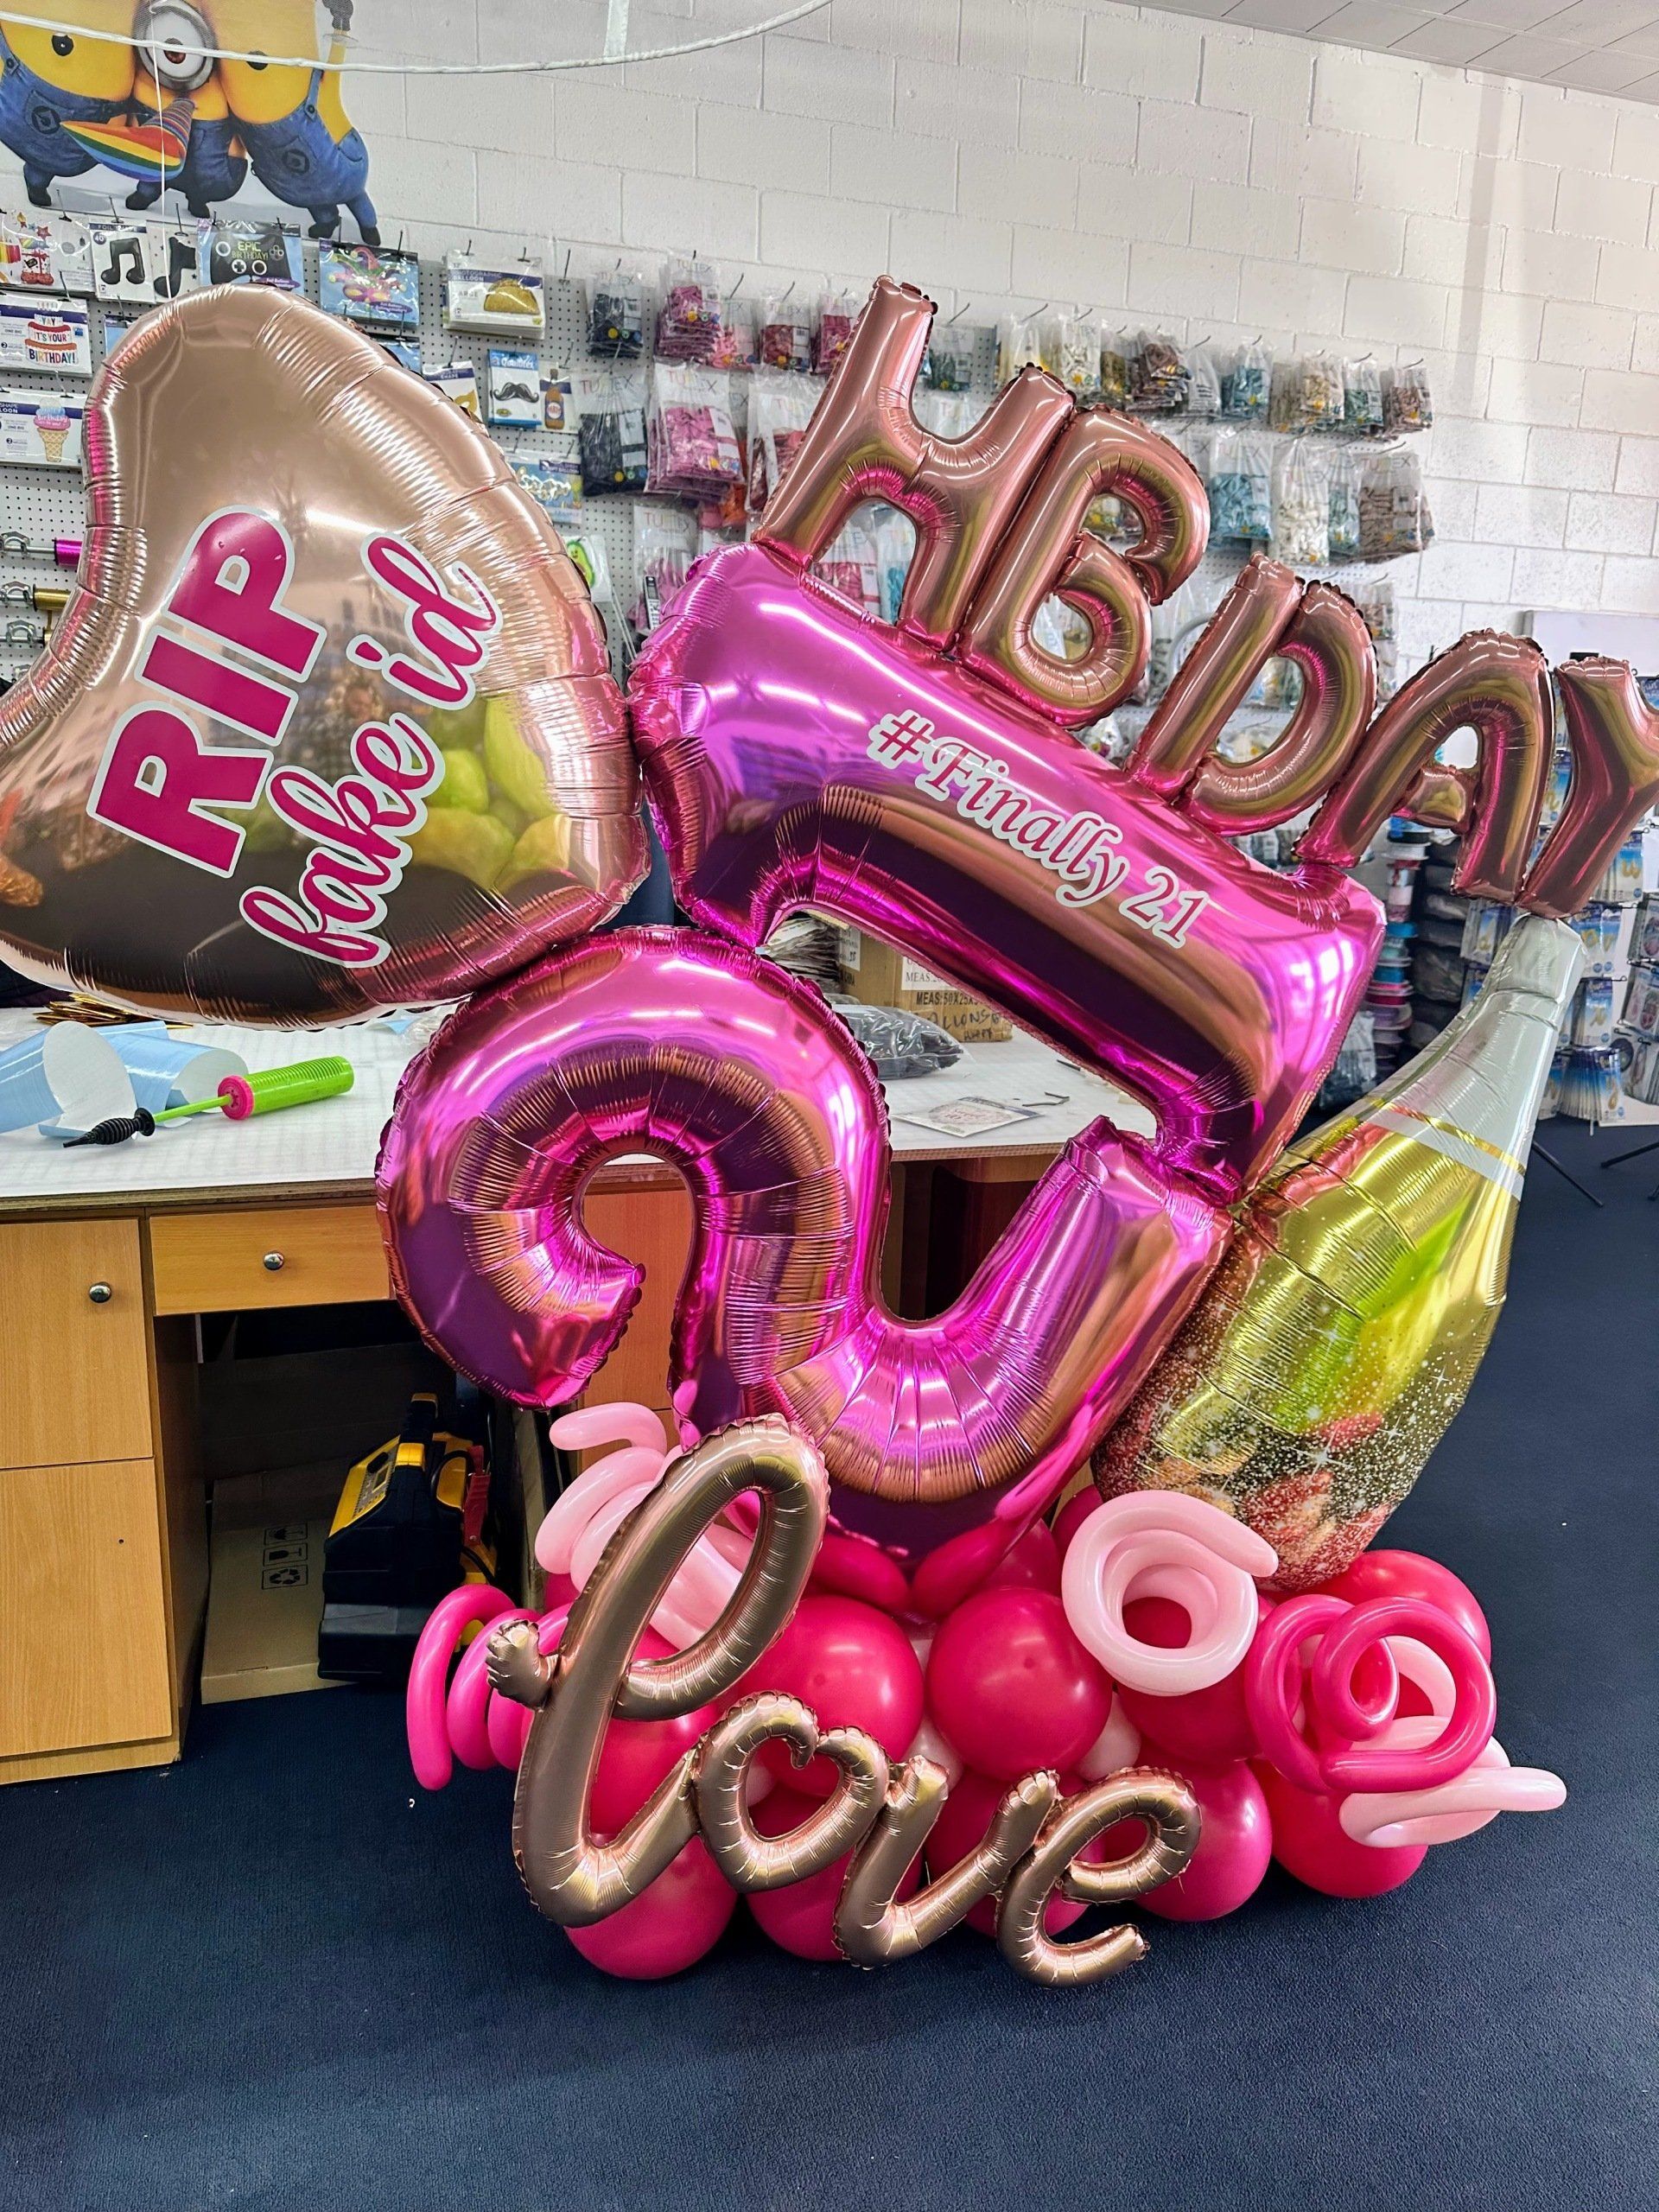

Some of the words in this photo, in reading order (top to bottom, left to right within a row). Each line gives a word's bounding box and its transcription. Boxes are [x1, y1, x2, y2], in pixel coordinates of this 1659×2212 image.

[238, 241, 261, 251] EPIC
[231, 251, 269, 260] BIRTHDAY!
[48, 334, 67, 343] YOUR
[29, 348, 76, 364] BIRTHDAY!
[92, 508, 323, 875] RIP
[243, 714, 440, 965] fake
[351, 533, 499, 705] id
[873, 712, 1129, 906] #Finally
[1124, 868, 1208, 946] 21
